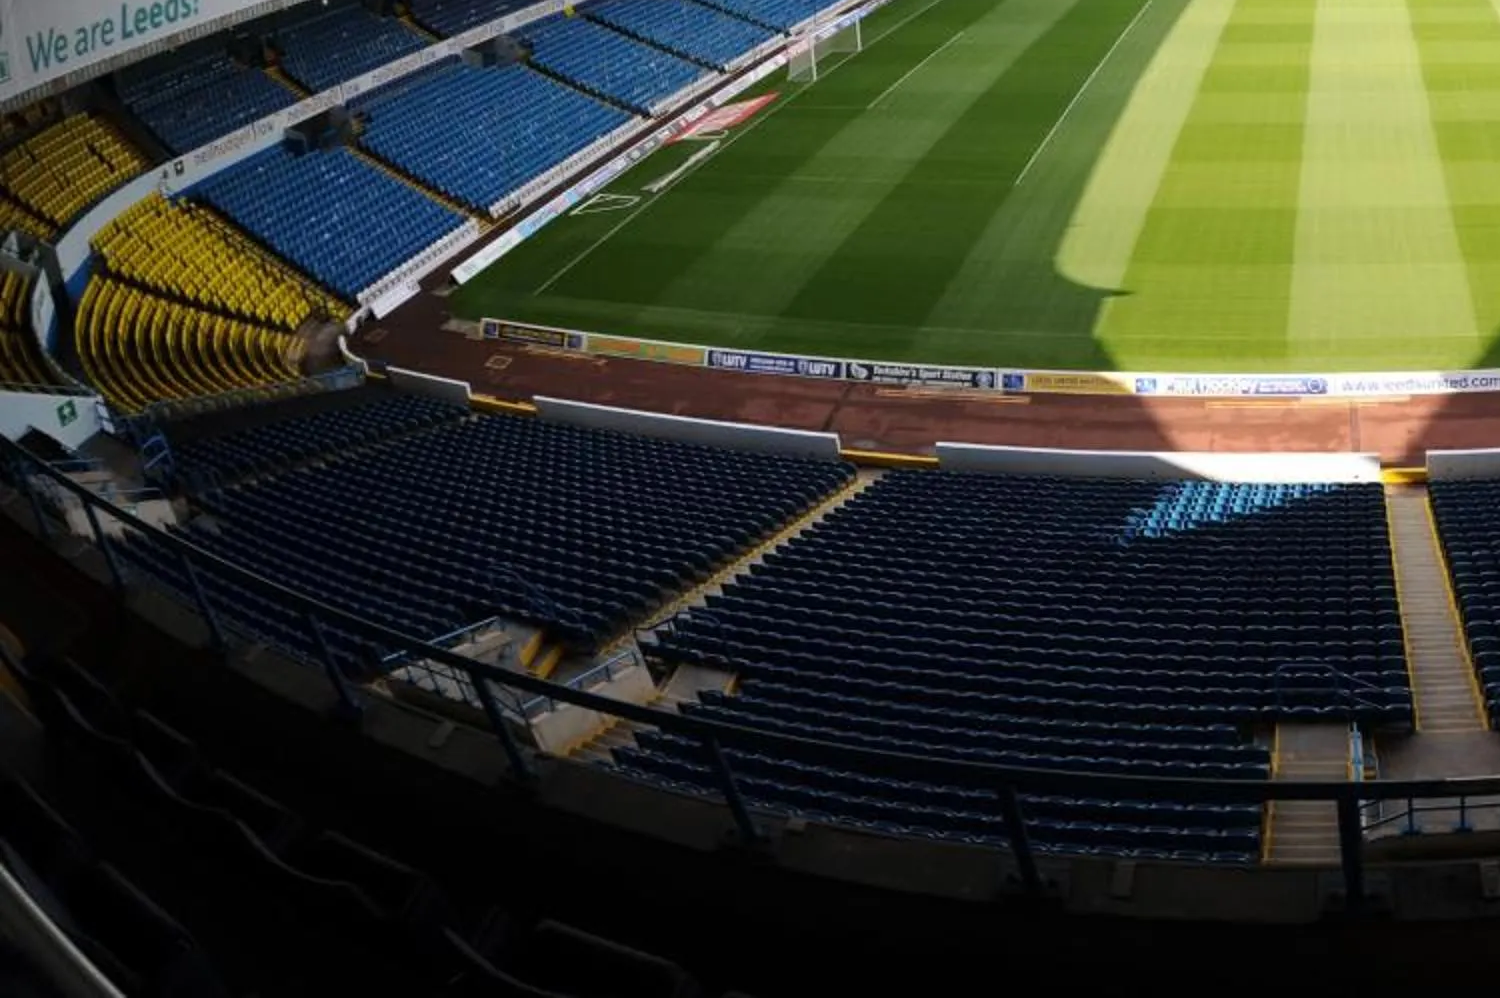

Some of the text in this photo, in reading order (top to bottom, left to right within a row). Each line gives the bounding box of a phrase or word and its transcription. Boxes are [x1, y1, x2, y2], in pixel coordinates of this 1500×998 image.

[26, 25, 69, 73] We
[74, 16, 115, 55] are
[723, 352, 747, 368] LUTV
[809, 361, 835, 376] LUTV
